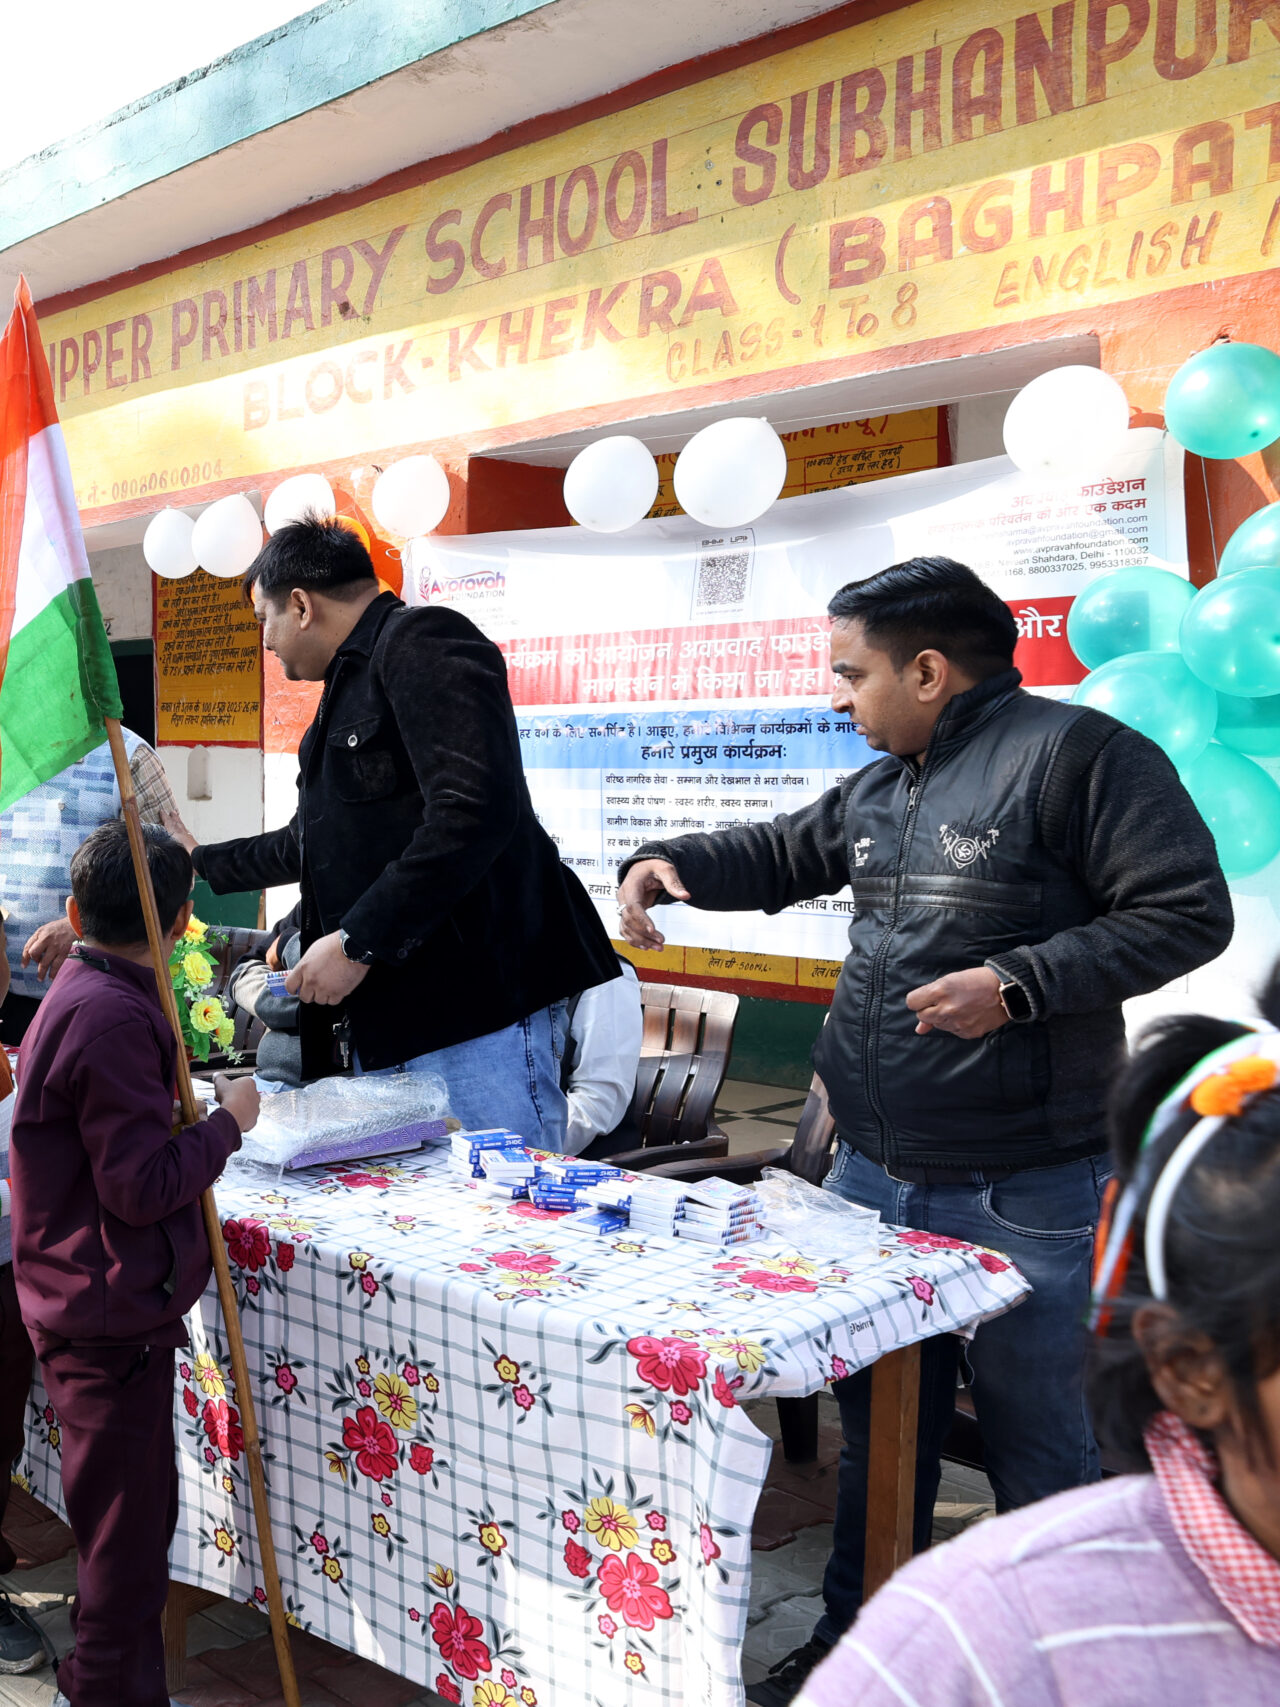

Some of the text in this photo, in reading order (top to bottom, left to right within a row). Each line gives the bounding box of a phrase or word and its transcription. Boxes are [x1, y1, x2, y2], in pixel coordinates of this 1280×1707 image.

[170, 224, 409, 371] PRIMARY
[425, 138, 699, 295] SCHOOL
[890, 281, 919, 328] 8
[993, 210, 1223, 308] ENGLISH
[1111, 498, 1147, 512] कदम
[1080, 550, 1105, 560] Delhi
[590, 633, 673, 665] आयोजन
[679, 634, 765, 662] अवप्रवाह
[1016, 606, 1064, 639] और
[581, 667, 664, 698] मार्गदर्शन
[671, 665, 690, 693] में
[695, 665, 746, 694] किया
[754, 667, 781, 689] जा
[789, 665, 825, 689] रहा
[519, 727, 531, 739] हर
[760, 717, 813, 735] कार्यक्रमों
[817, 717, 830, 734] के
[641, 740, 676, 761] हमारे
[680, 745, 718, 765] प्रमुख
[605, 772, 624, 784] वरिष्ठ
[626, 772, 652, 784] नागरिक
[653, 773, 668, 785] सेवा
[676, 776, 702, 785] सम्मान
[704, 773, 719, 785] और
[720, 773, 751, 786] देखभाल
[753, 773, 761, 785] से
[763, 776, 779, 786] भरा
[632, 794, 645, 806] और
[606, 814, 628, 826] ग्रामीण
[630, 814, 652, 827] विकास
[654, 816, 668, 828] और
[670, 816, 705, 829] आजीविका
[588, 881, 611, 895] हमारे
